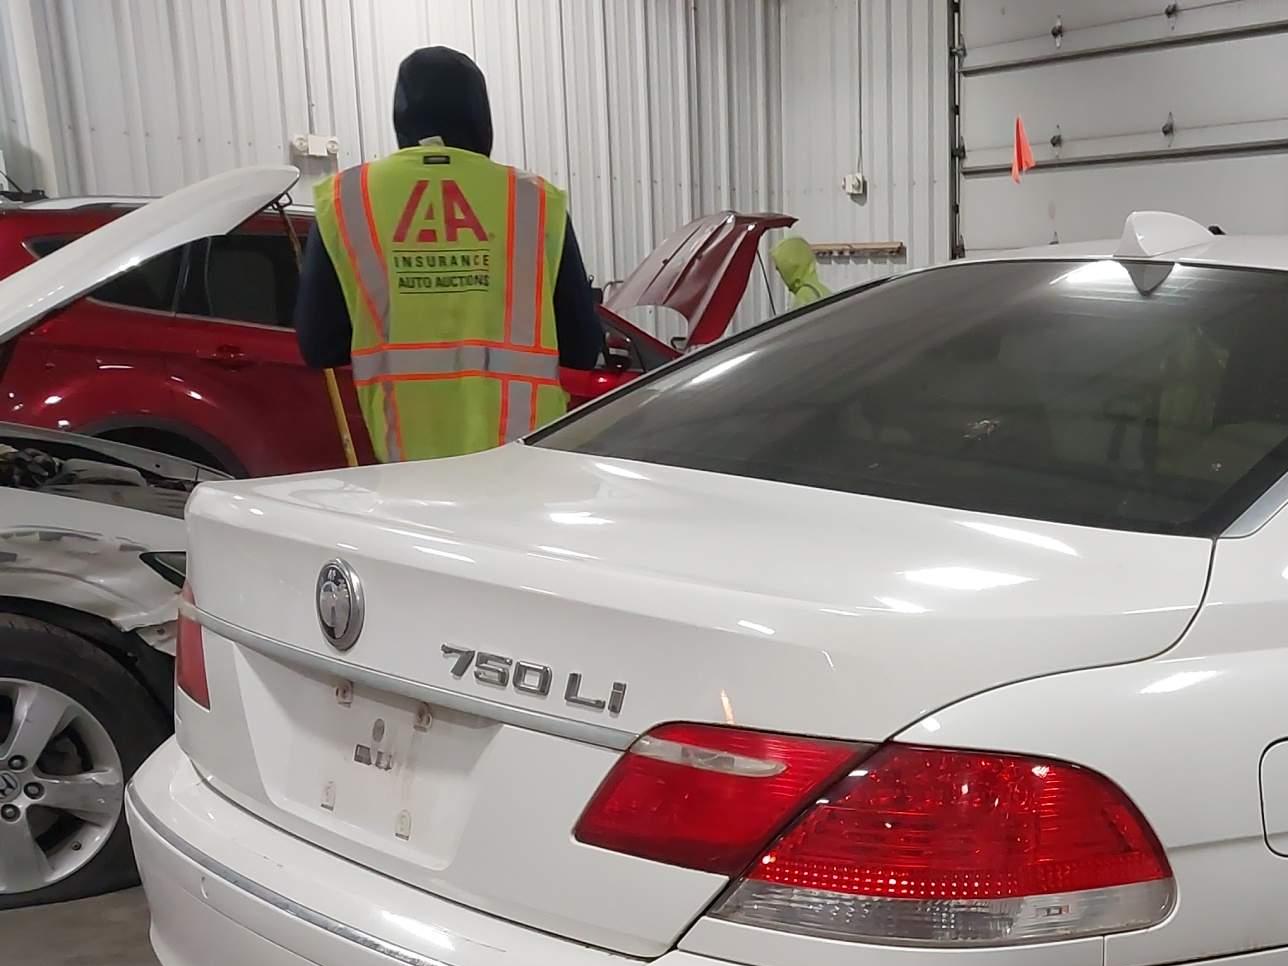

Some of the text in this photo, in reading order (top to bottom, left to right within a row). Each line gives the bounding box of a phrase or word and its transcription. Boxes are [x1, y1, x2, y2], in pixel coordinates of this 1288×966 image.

[394, 254, 489, 268] INSURANCE
[398, 274, 489, 289] AUTO AUCTIONS
[441, 644, 627, 714] 750 Li
